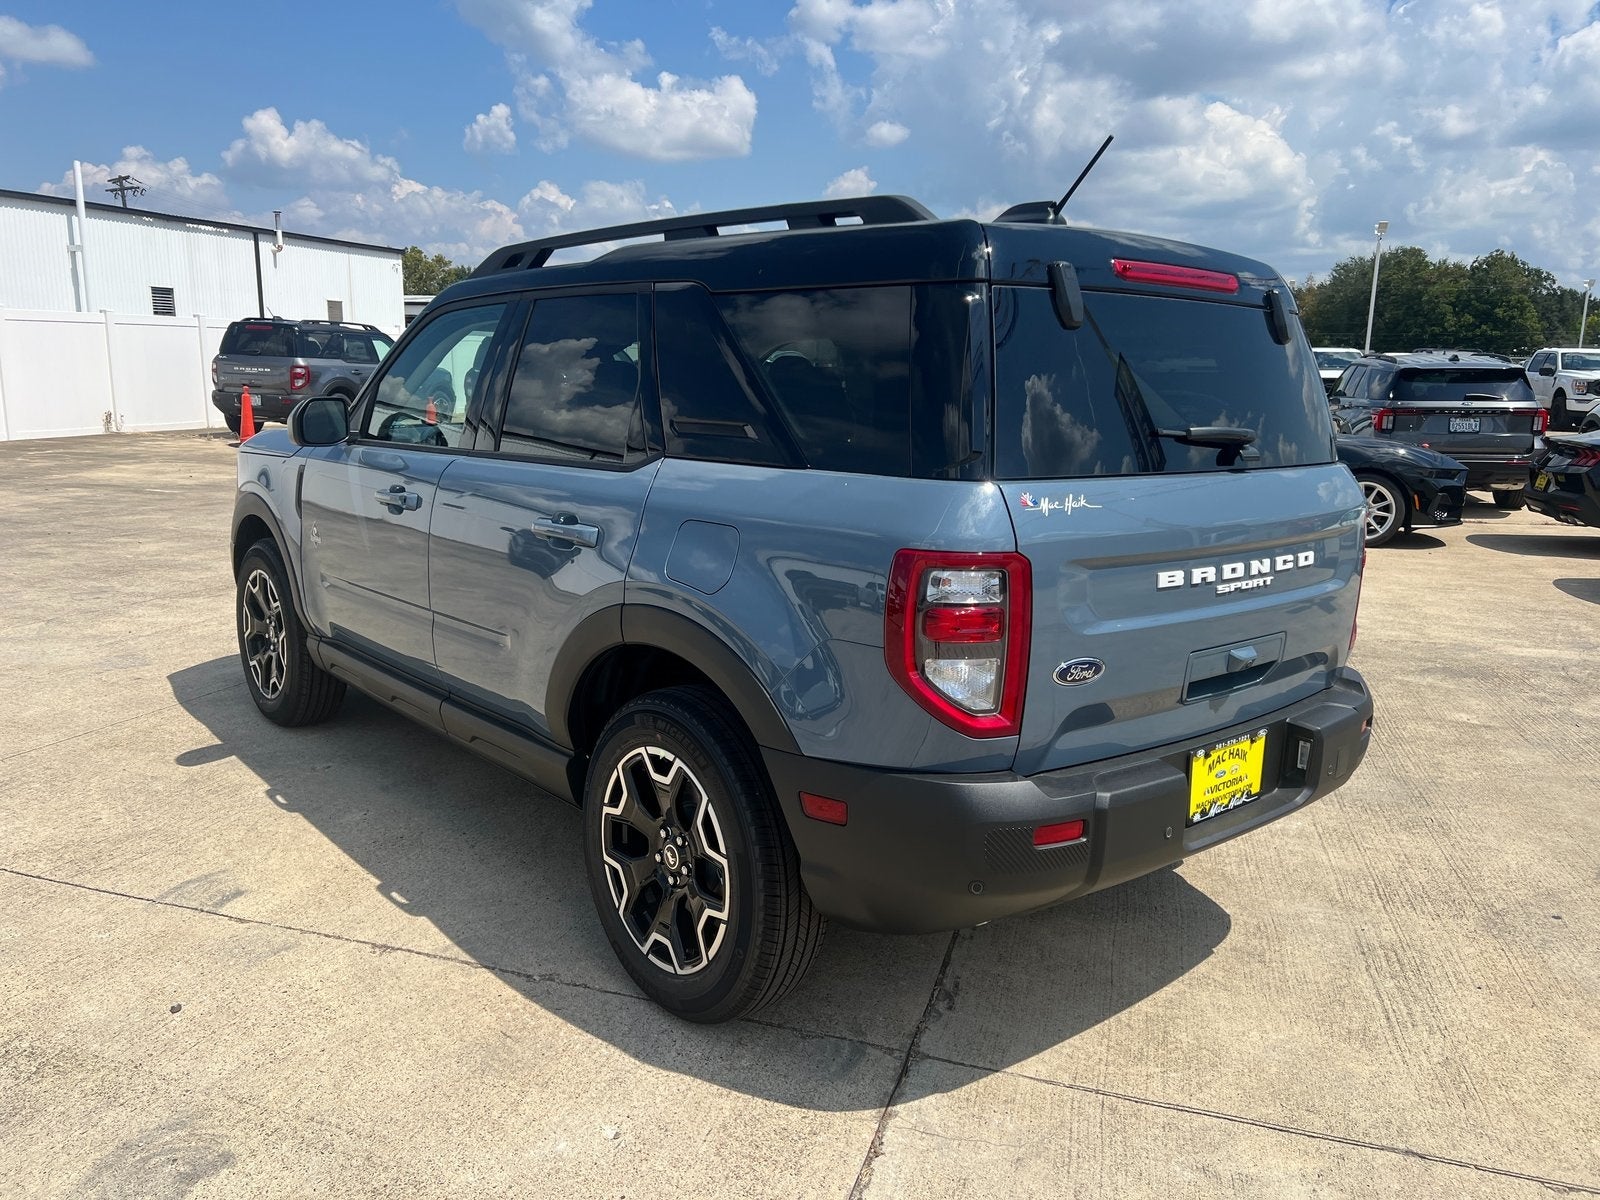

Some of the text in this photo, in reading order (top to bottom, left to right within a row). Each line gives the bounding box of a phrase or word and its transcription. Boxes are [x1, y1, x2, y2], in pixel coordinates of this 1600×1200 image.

[1028, 493, 1103, 517] Mac Haik
[1157, 550, 1315, 589] BRONCO
[1215, 576, 1275, 594] SPORT
[1066, 663, 1096, 681] Ford
[1207, 750, 1227, 775] MAC
[1228, 747, 1248, 763] HAIK
[1210, 774, 1243, 794] VICTORIA
[1228, 789, 1258, 810] Haik
